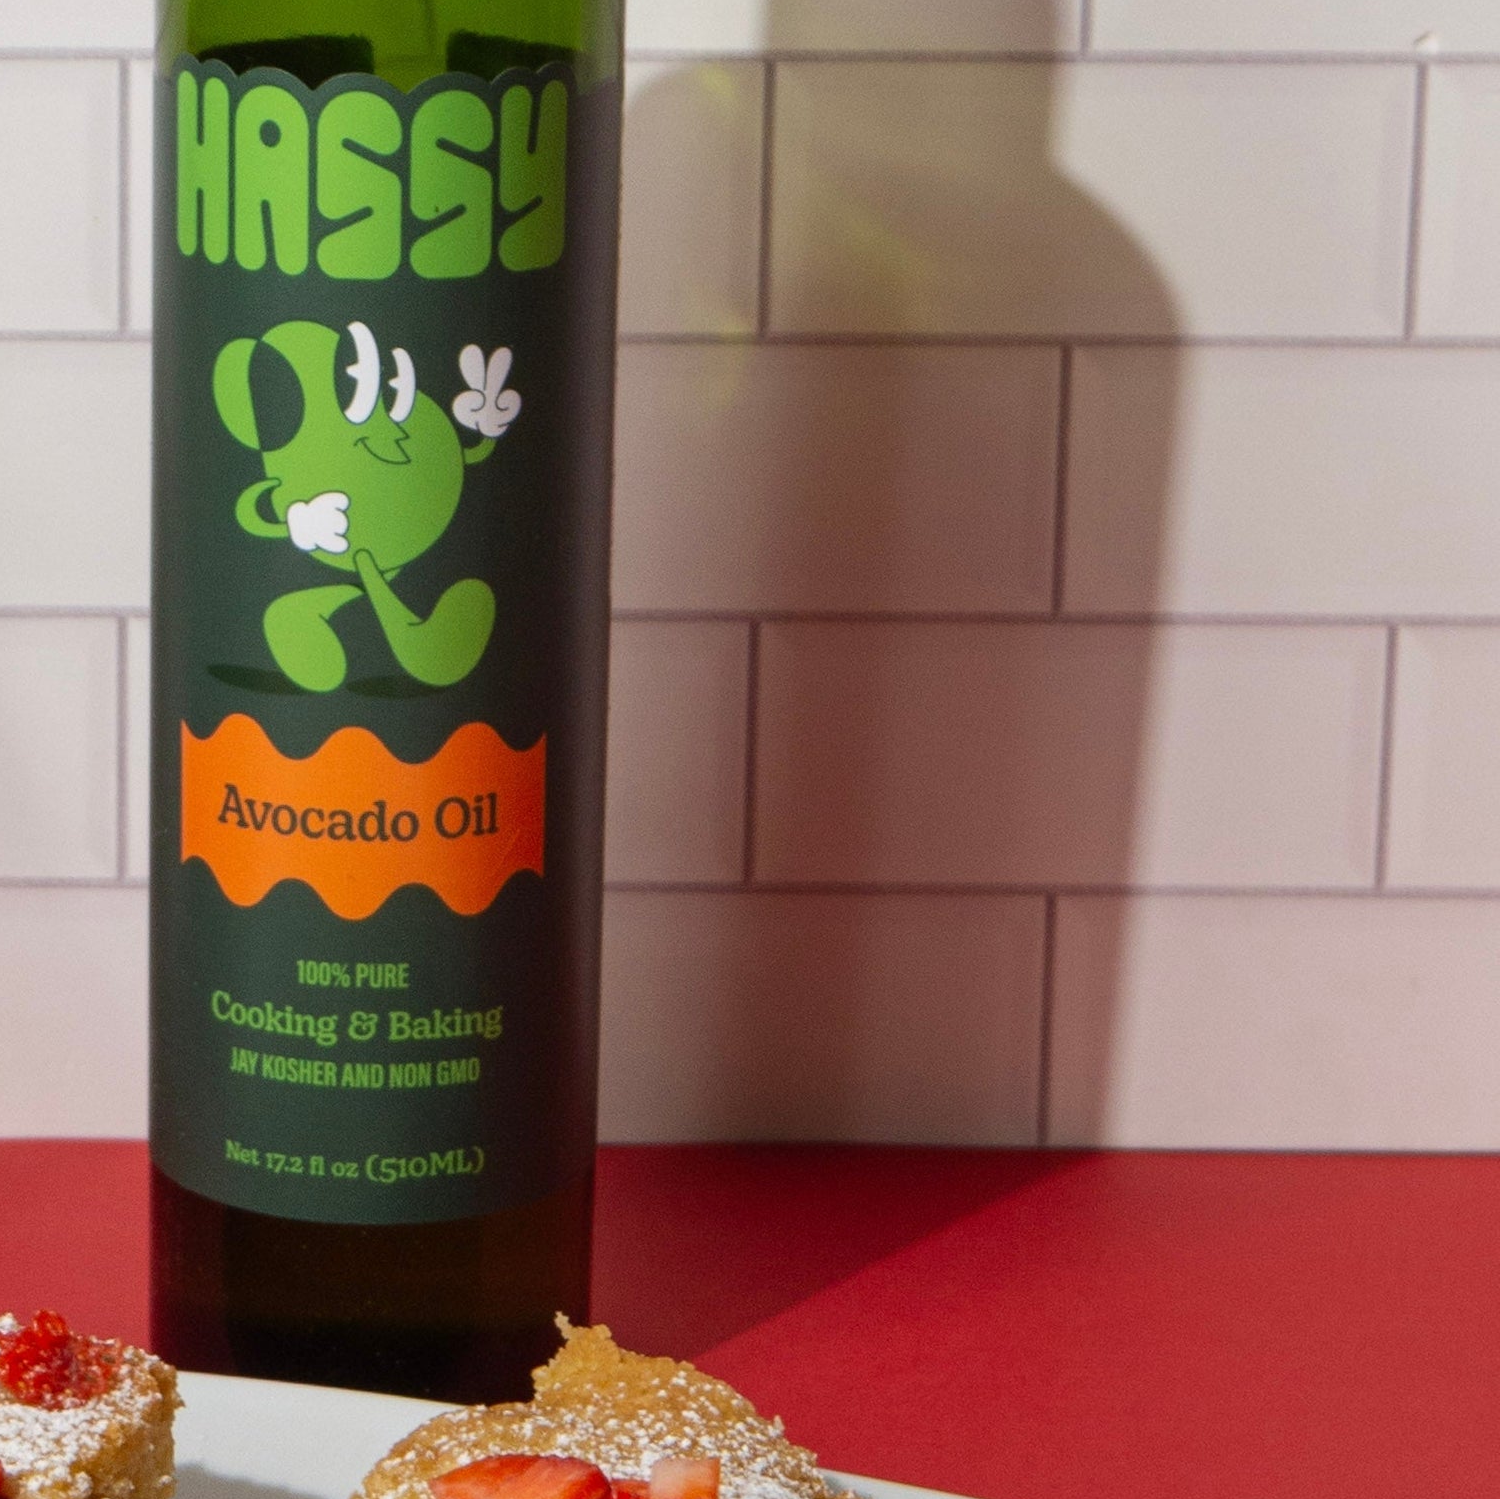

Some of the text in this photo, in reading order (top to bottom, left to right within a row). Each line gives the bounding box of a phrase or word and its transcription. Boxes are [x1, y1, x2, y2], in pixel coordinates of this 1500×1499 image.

[176, 69, 568, 280] HASSY
[217, 783, 500, 842] Avocado Oil
[296, 959, 411, 989] 100% PURE
[211, 990, 504, 1045] Cooking & Baking
[231, 1047, 481, 1089] JAY KOSHER AND NON GMO
[225, 1139, 485, 1185] Net 17.2 fl oz (510ML)
